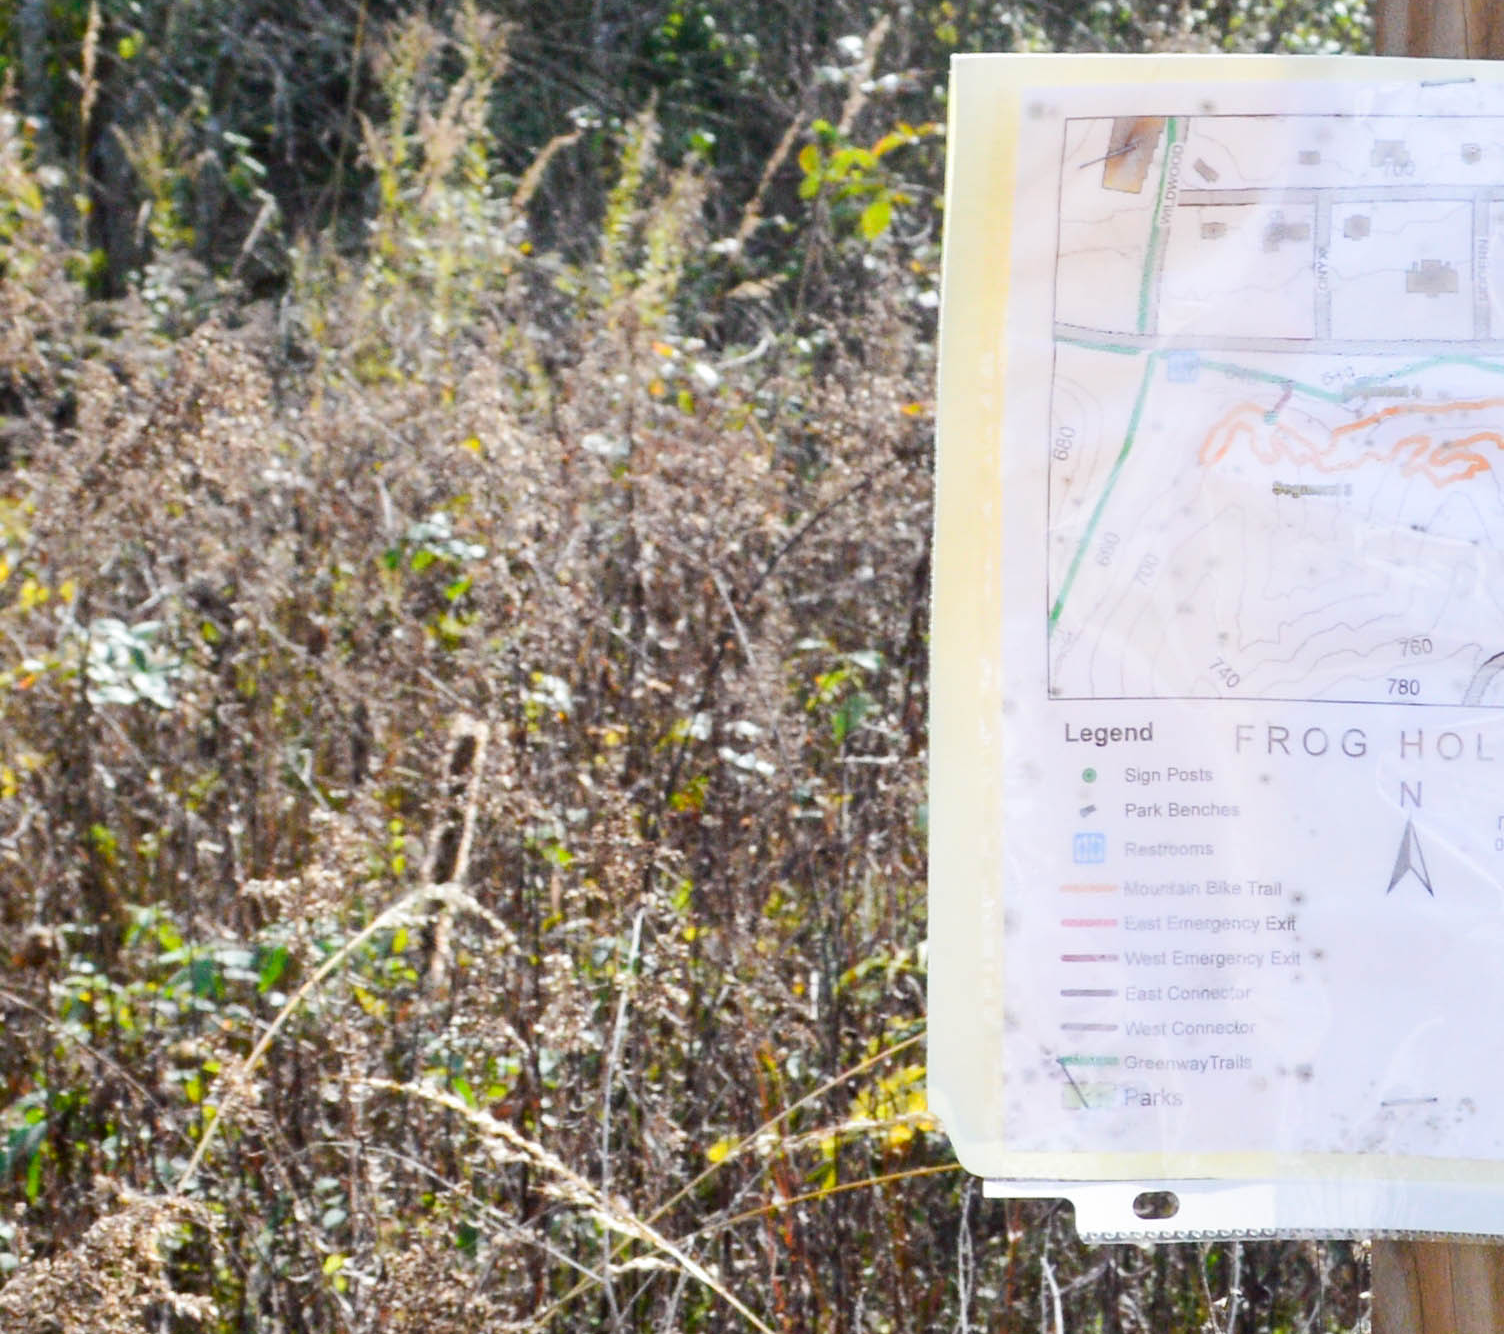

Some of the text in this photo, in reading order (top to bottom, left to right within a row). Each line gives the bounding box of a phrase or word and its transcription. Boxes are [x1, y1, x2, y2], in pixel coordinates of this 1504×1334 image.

[1159, 142, 1184, 225] WILDWOOD
[1052, 425, 1076, 462] 680
[1399, 638, 1434, 657] 760
[1208, 657, 1241, 689] 740
[1387, 678, 1421, 697] 780
[1064, 721, 1154, 747] Legend
[1234, 723, 1369, 759] FROG
[1124, 766, 1214, 786] Sign Posts
[1399, 779, 1423, 809] N
[1124, 801, 1241, 819] Park Benches
[1124, 841, 1215, 858] Restrooms
[1123, 879, 1283, 897] Mountain Bike Trail
[1124, 915, 1297, 934] East Emergency Exit
[1124, 949, 1302, 969] West Emergency Exit
[1124, 986, 1163, 1002] East
[1124, 1019, 1256, 1037] West Connector
[1123, 1087, 1184, 1107] Parks
